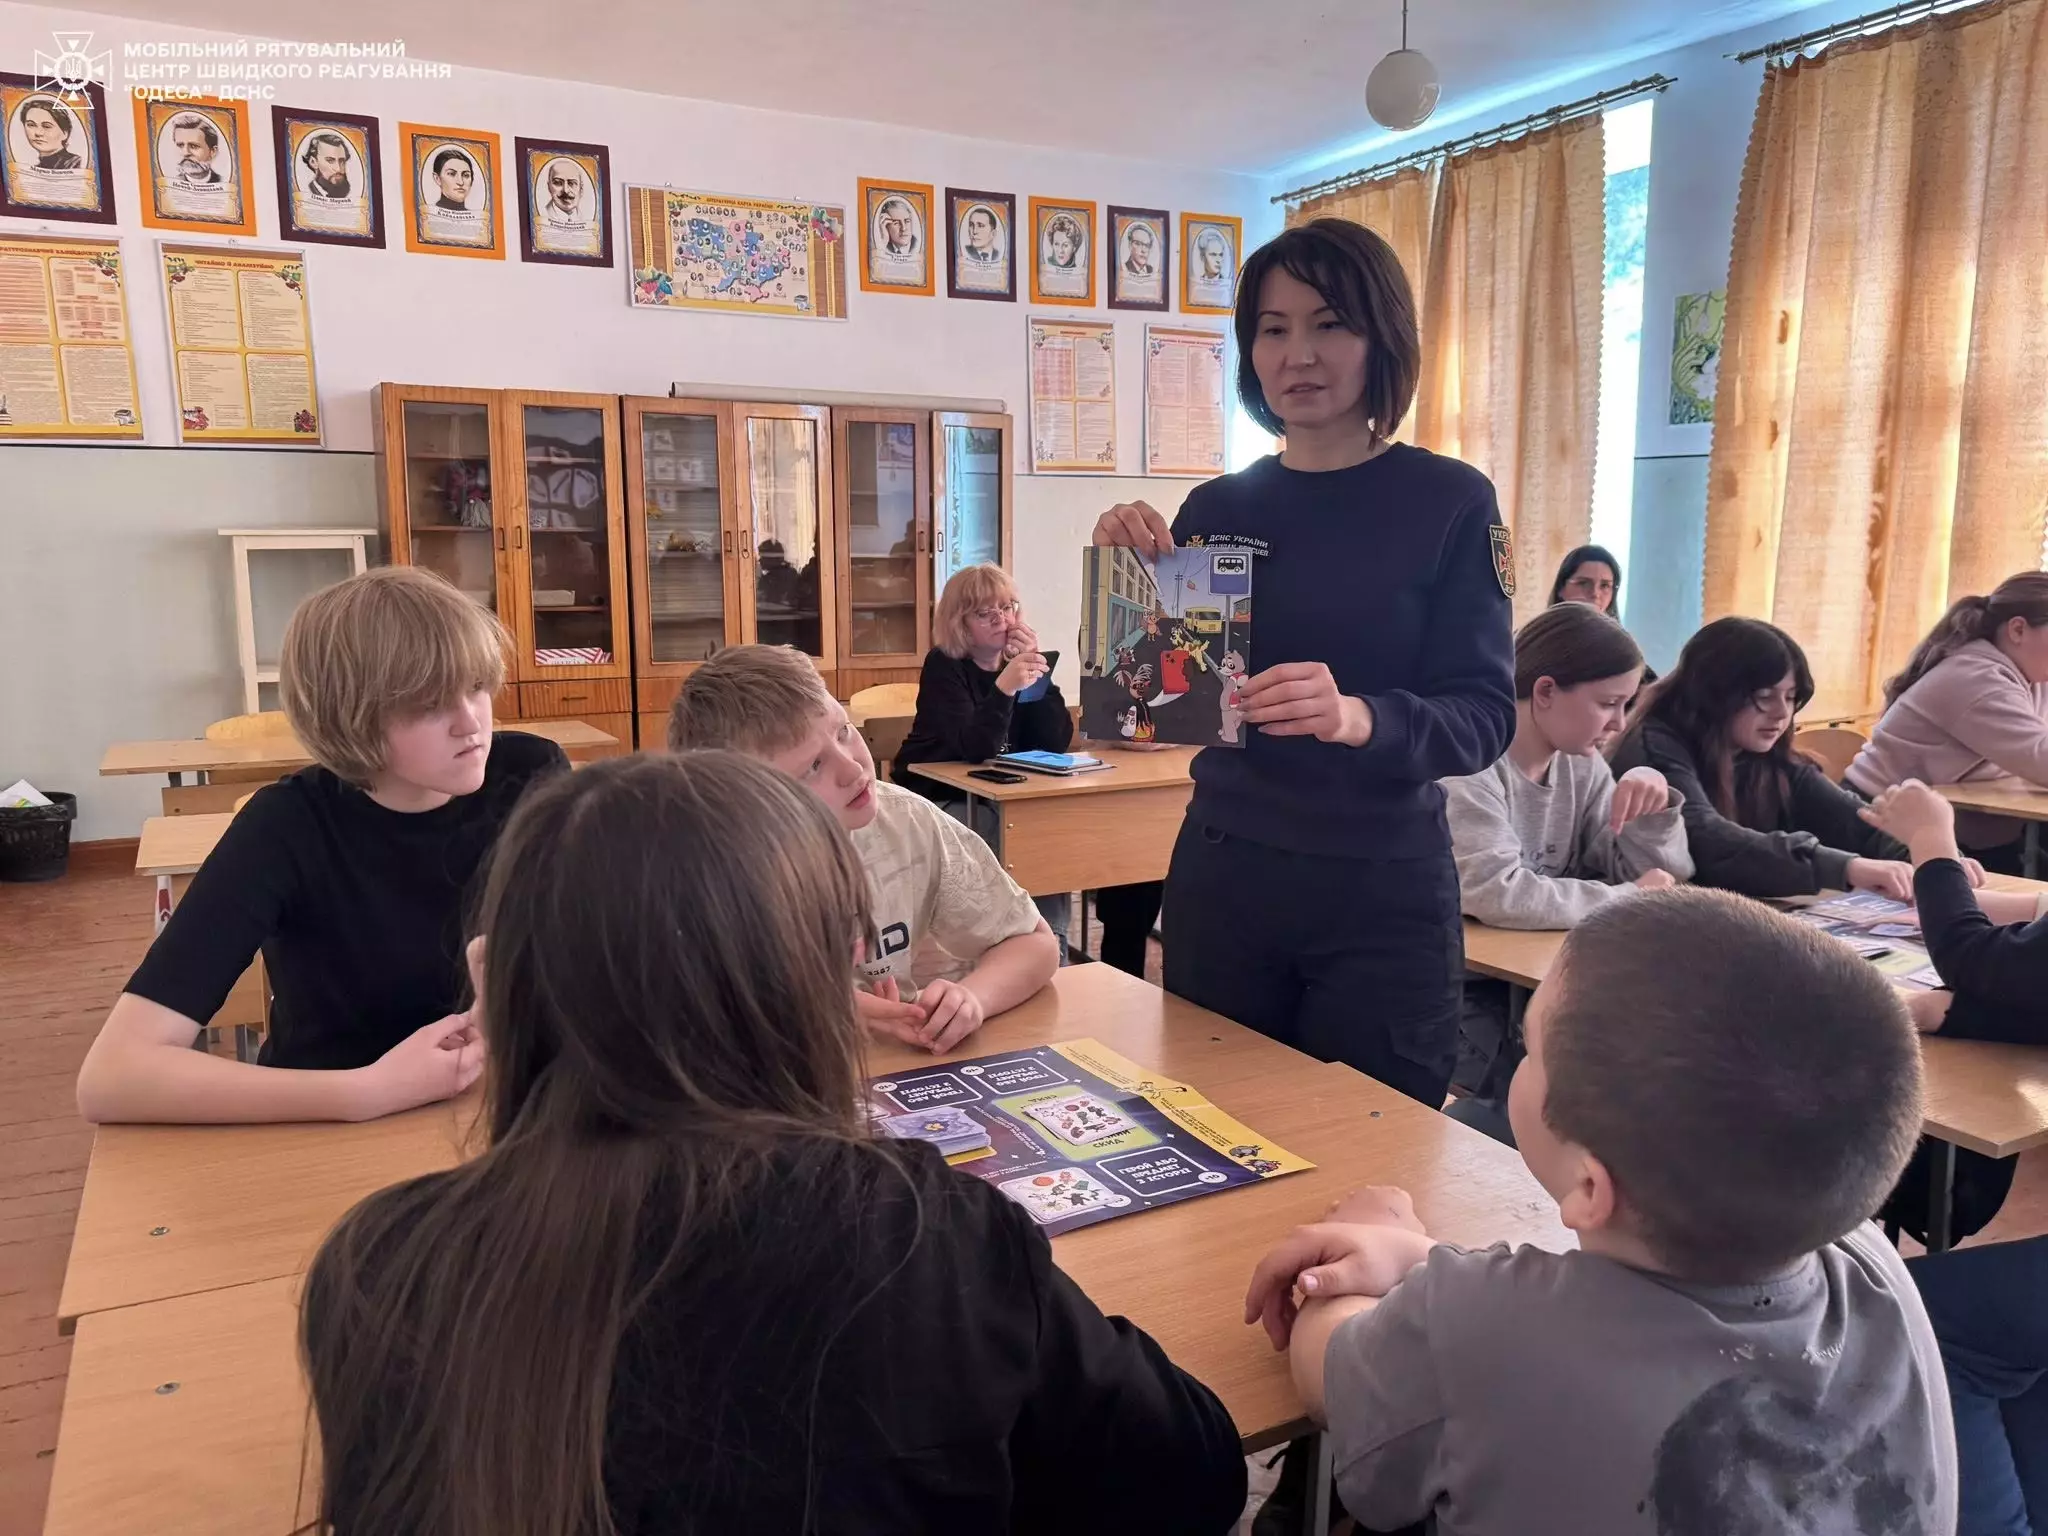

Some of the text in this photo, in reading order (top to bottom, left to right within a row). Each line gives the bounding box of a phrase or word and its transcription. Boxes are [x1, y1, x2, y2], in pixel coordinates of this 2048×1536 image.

[1208, 534, 1269, 549] ДСНС УКРАЇНИ
[1092, 1138, 1125, 1148] СКИД
[1117, 1157, 1179, 1175] ГЕРОЙ АБО
[1131, 1163, 1181, 1179] ПРЕДМЕТ
[1147, 1167, 1193, 1183] ІСТОРІЇ
